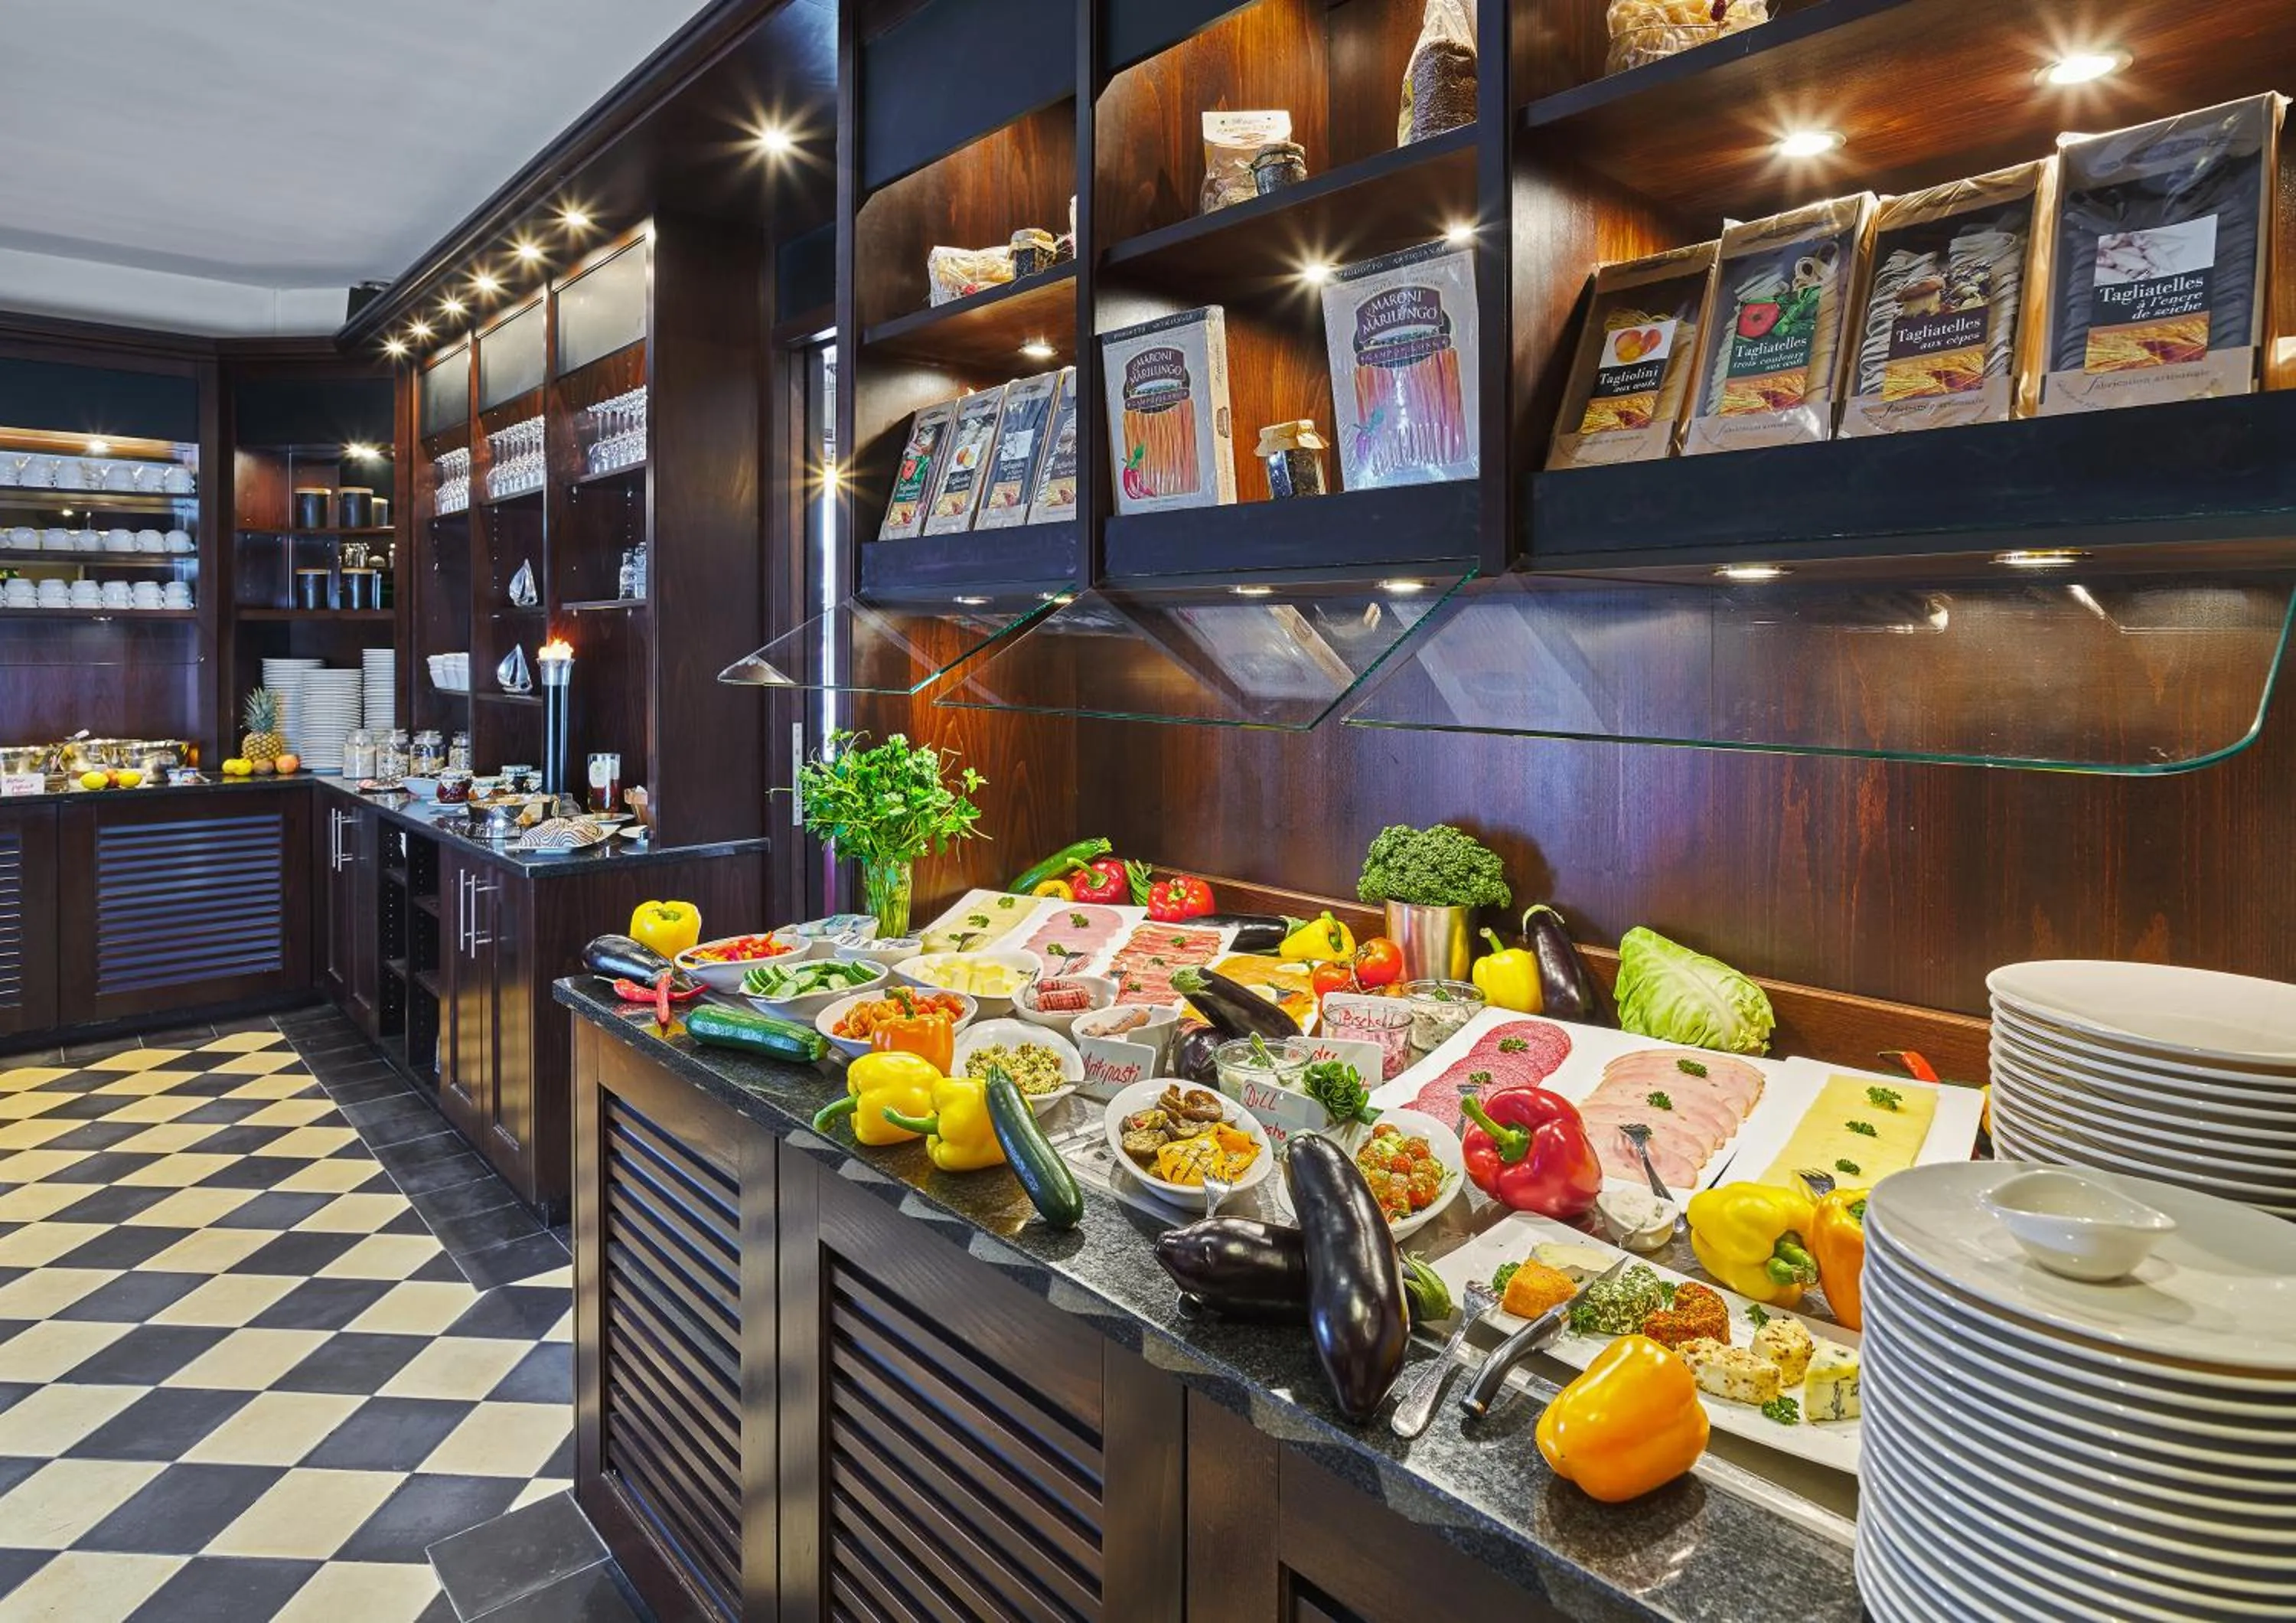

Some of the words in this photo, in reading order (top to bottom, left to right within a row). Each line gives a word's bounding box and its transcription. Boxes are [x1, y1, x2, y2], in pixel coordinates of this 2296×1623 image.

[1371, 290, 1422, 310] MARONI
[2099, 276, 2203, 305] Tagliatelles
[2151, 292, 2203, 307] l'encre
[2131, 309, 2151, 319] de
[2153, 302, 2202, 315] seiche
[1896, 318, 1981, 343] Tagliatelles
[1735, 336, 1807, 360] Tagliatelles
[1600, 365, 1658, 386] Tagliolini
